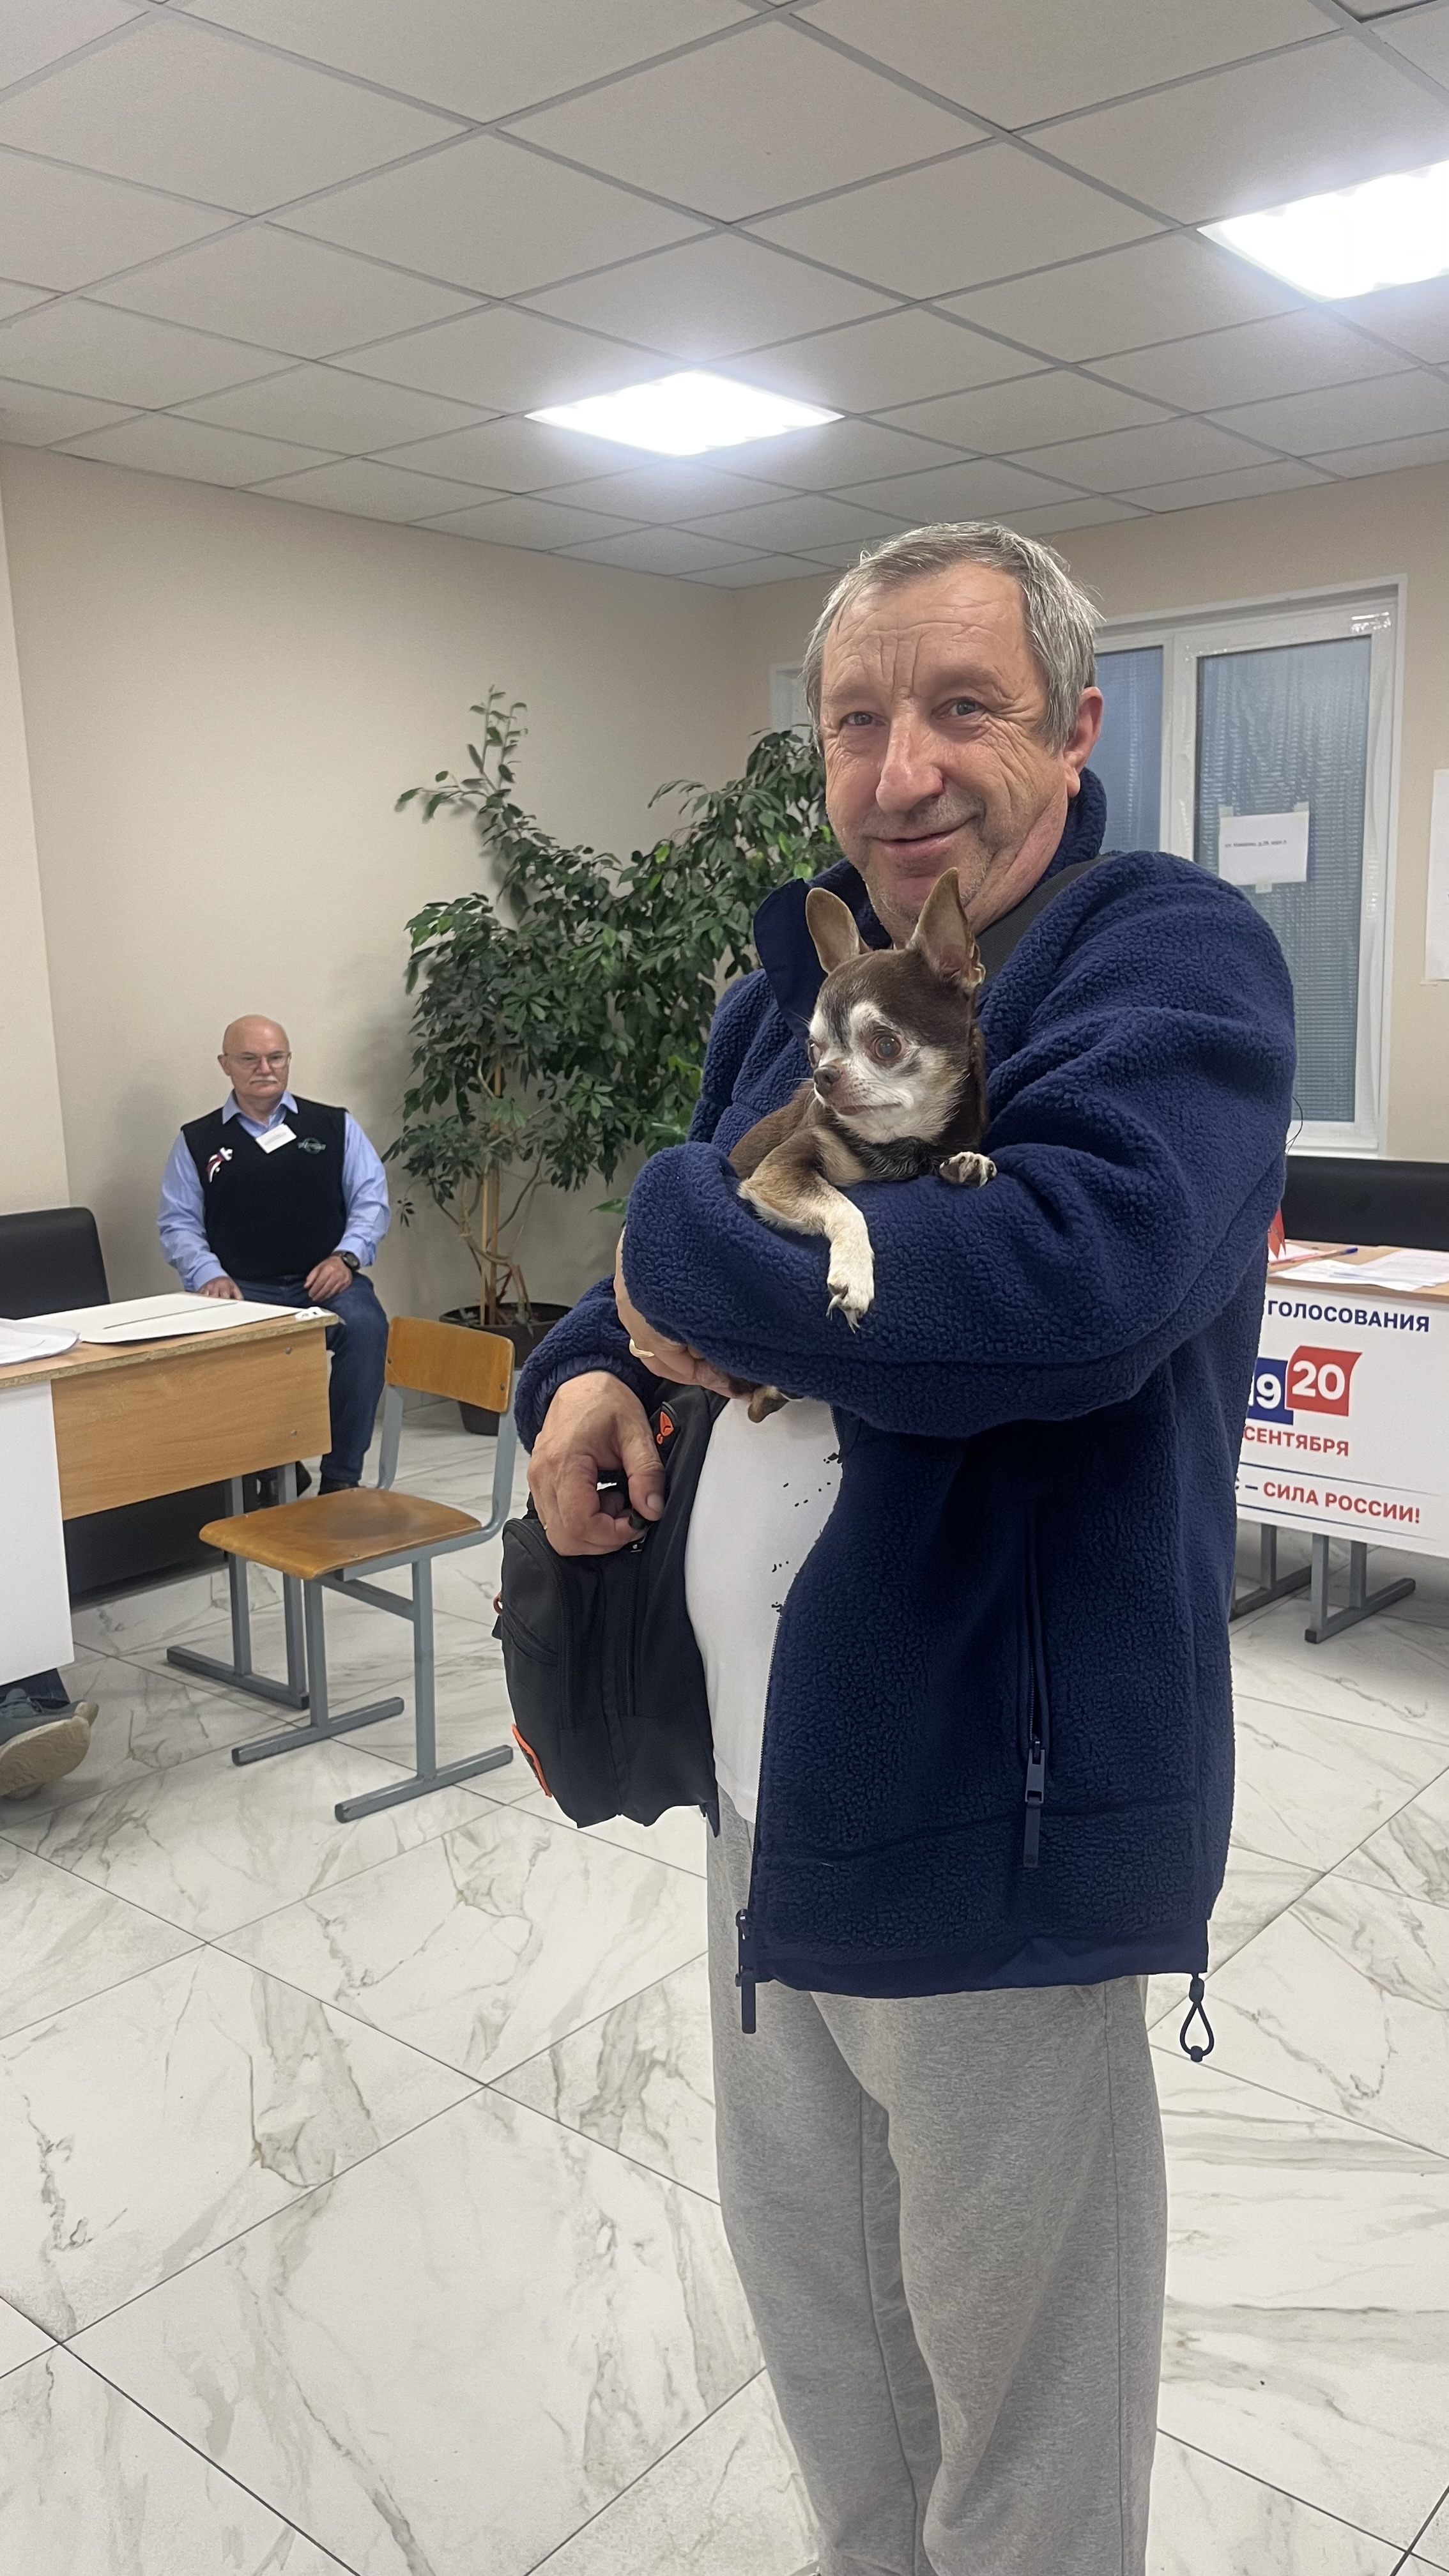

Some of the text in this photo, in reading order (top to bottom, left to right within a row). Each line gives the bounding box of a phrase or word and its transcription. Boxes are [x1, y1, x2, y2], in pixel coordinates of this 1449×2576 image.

[1268, 1300, 1429, 1332] ГОЛОСОВАНИЯ
[1292, 1360, 1346, 1401] 20
[1244, 1426, 1349, 1456] СЕНТЯБРЯ
[1263, 1482, 1319, 1505] СИЛА
[1324, 1493, 1420, 1523] РОССИИ!
